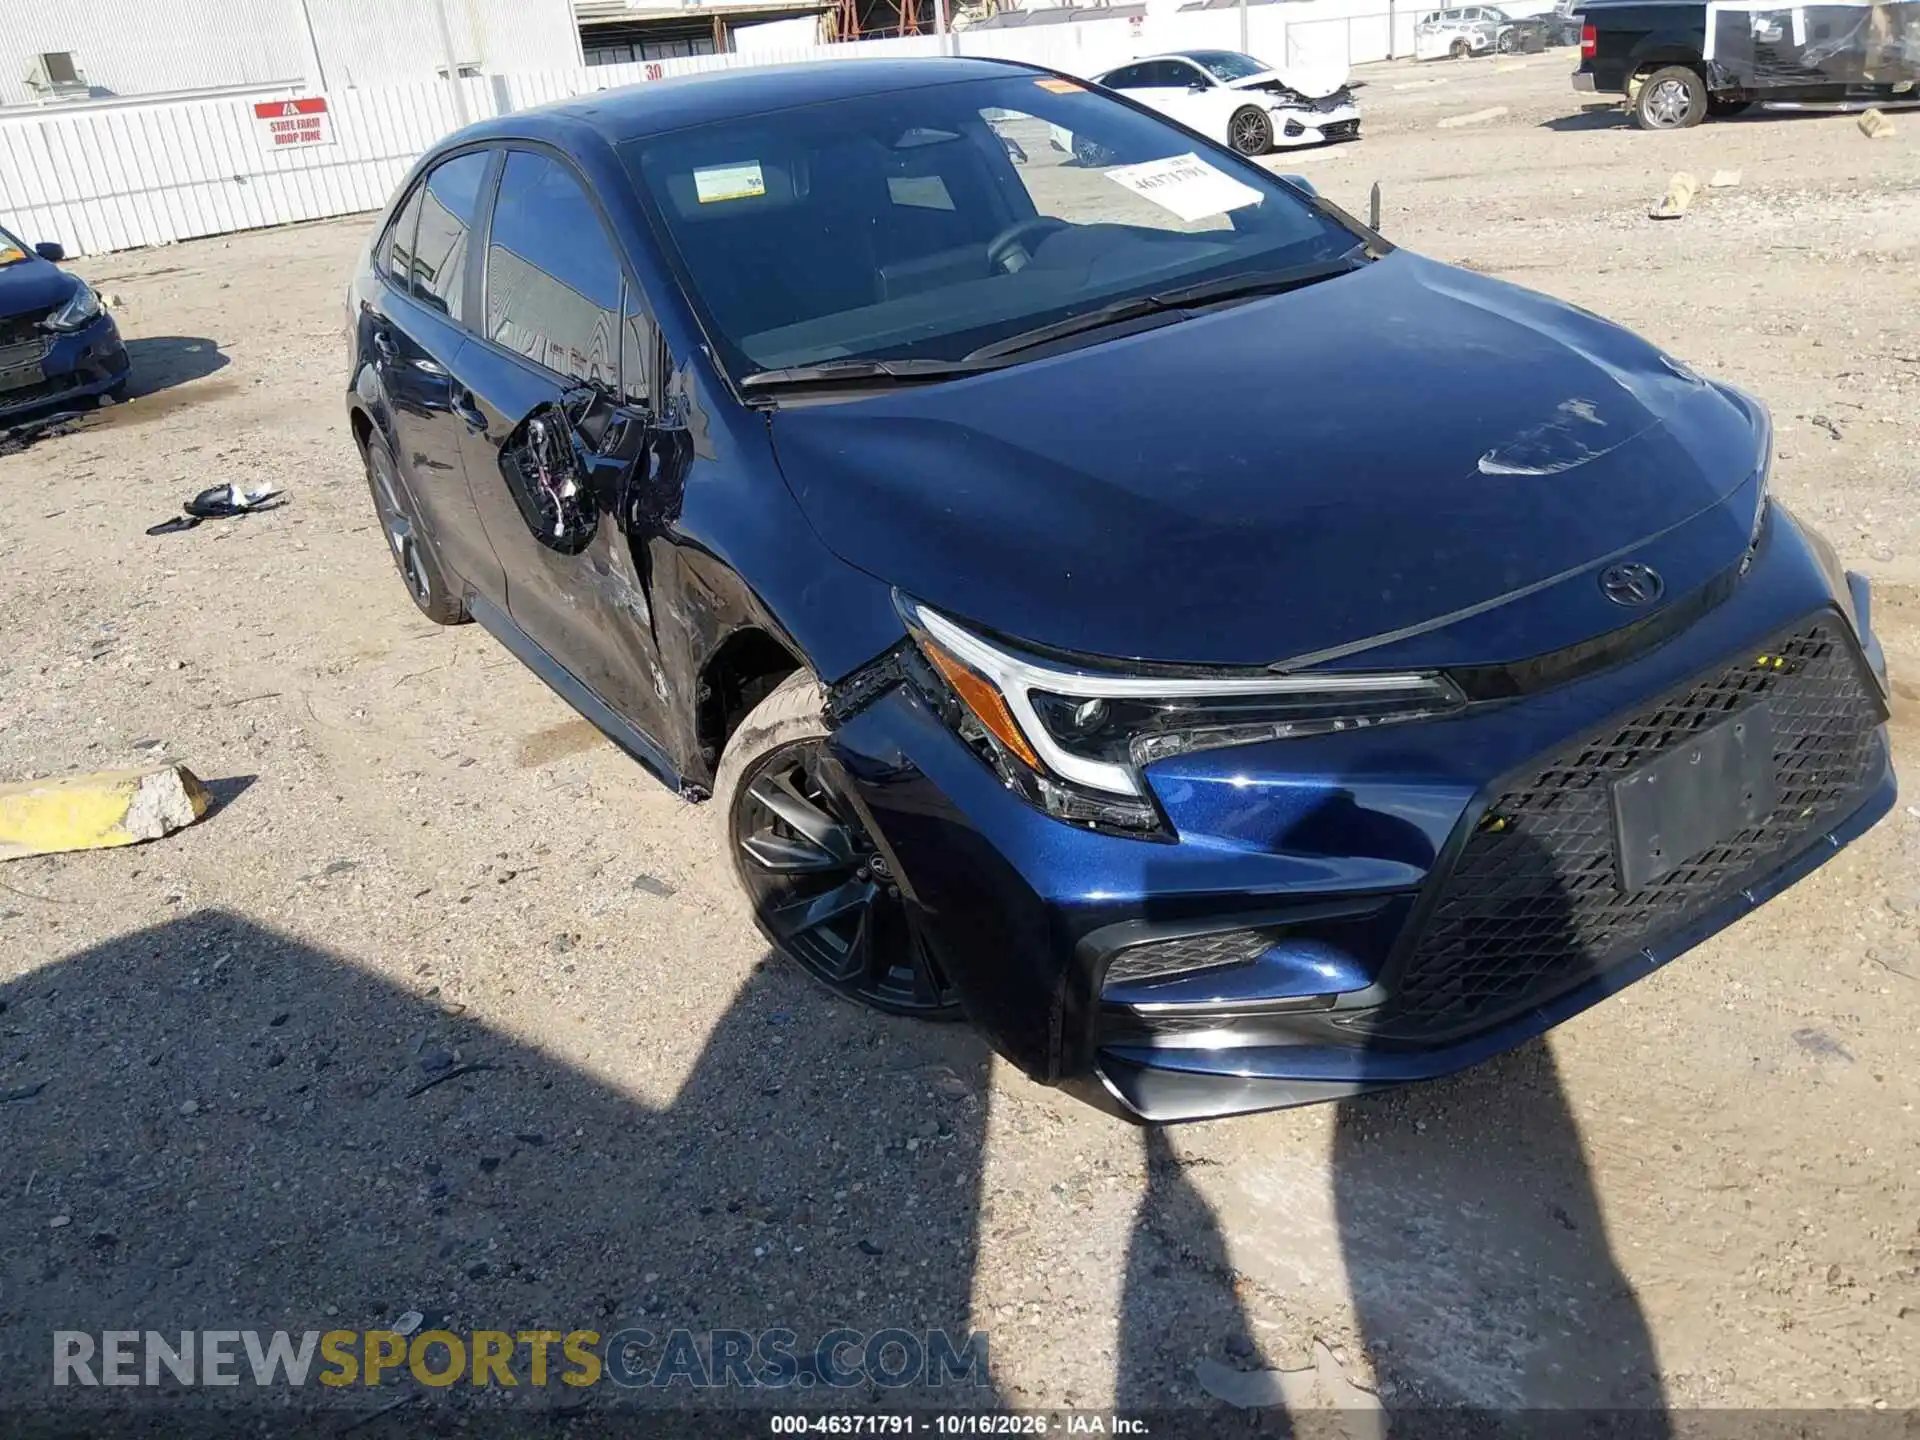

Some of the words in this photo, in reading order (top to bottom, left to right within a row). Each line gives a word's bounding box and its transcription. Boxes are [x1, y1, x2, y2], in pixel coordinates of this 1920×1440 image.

[644, 63, 662, 80] 30
[270, 120, 296, 132] STATE
[296, 117, 320, 129] FARM
[275, 132, 299, 145] DROP
[301, 130, 321, 142] ZONE
